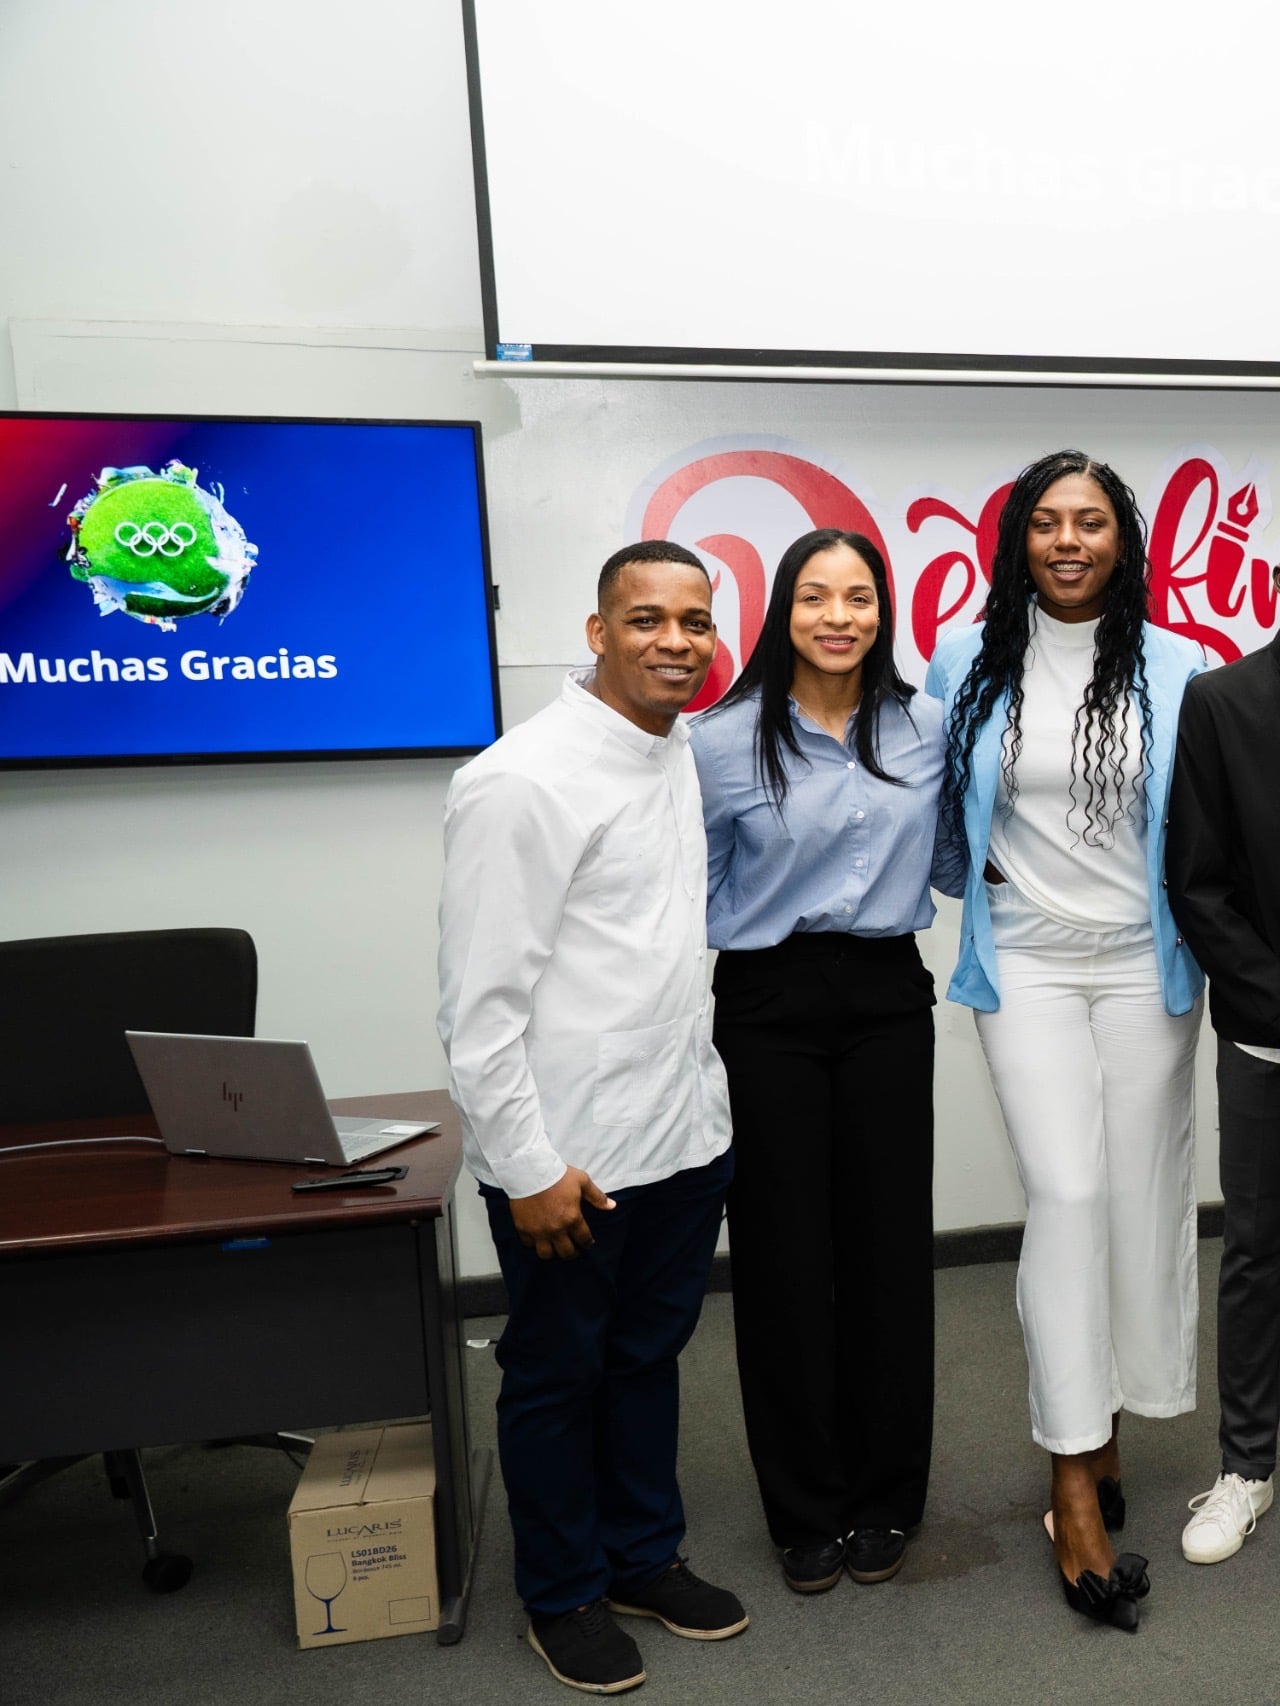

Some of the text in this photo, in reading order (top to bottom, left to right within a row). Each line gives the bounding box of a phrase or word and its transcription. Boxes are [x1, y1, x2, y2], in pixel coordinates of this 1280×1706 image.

[802, 120, 1104, 201] Muchas
[0, 648, 338, 684] Muchas Gracias
[326, 1519, 402, 1537] LUCARIS
[351, 1555, 387, 1567] Bangkok
